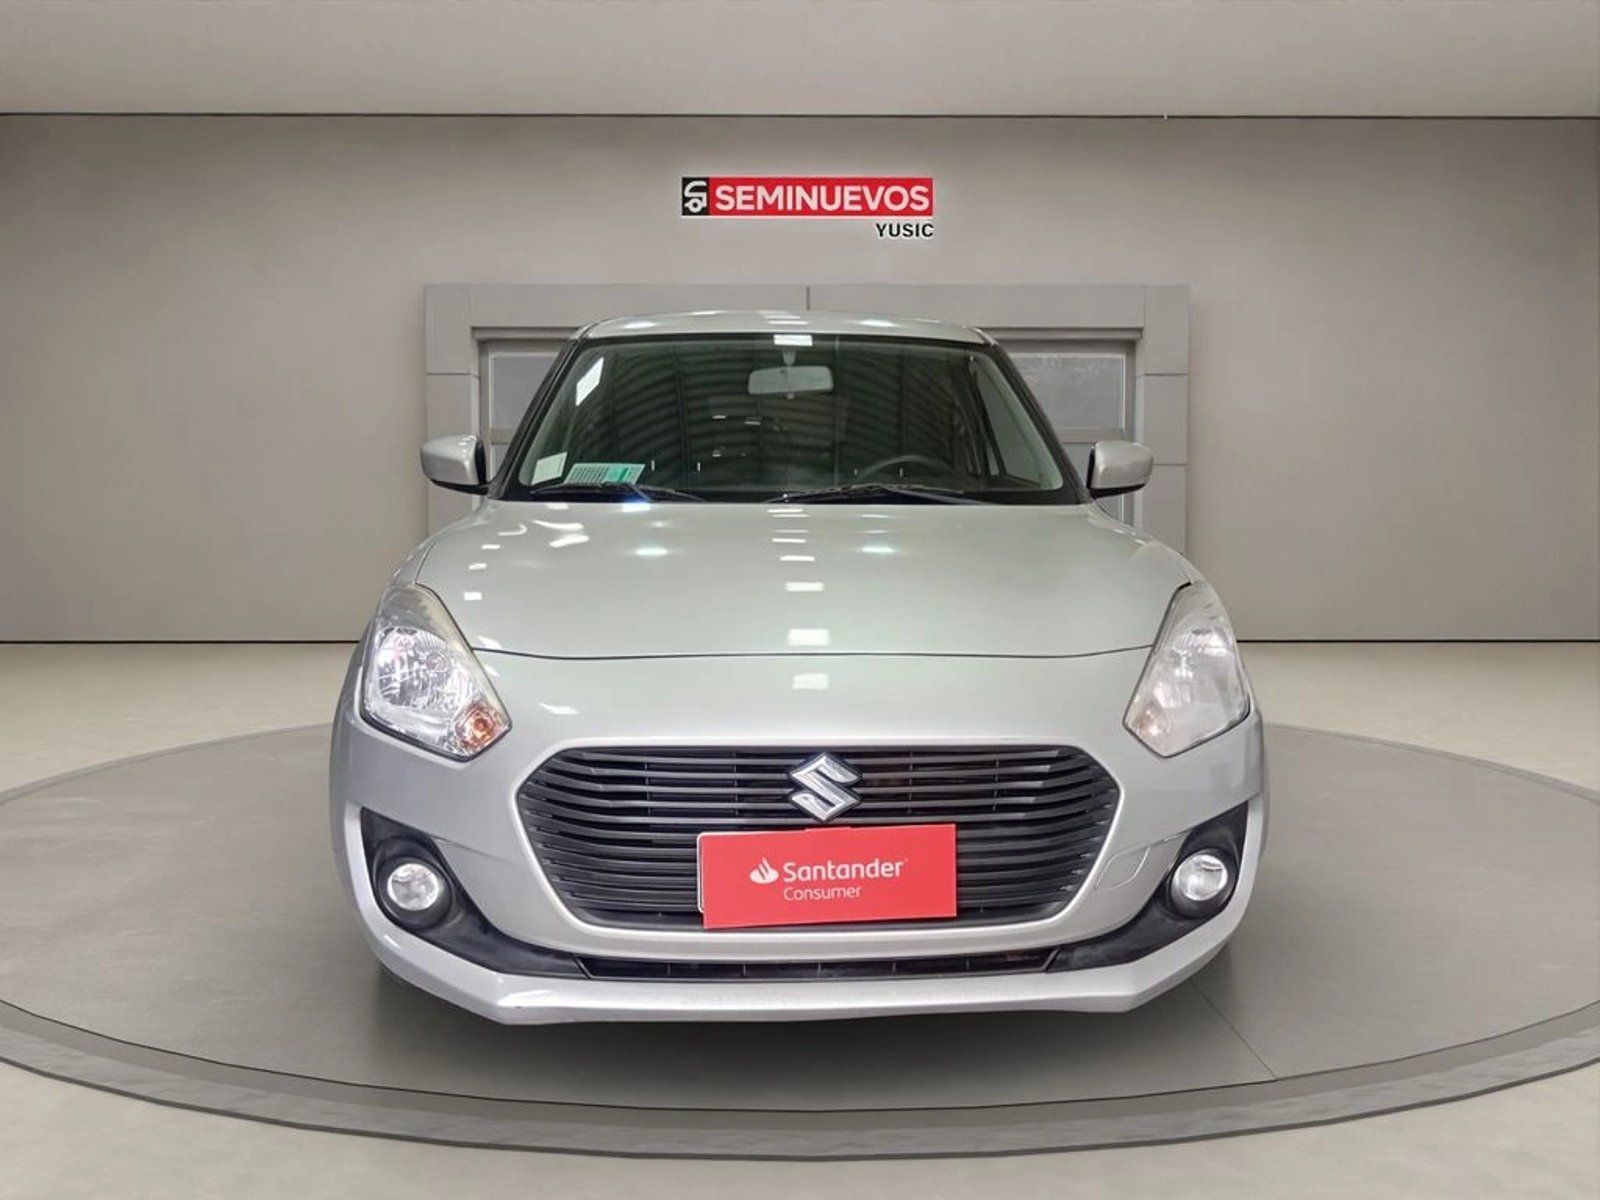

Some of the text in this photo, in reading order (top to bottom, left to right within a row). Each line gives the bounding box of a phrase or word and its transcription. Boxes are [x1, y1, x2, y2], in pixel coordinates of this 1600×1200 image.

[715, 185, 929, 211] SEMINUEVOS
[875, 223, 934, 237] YUSIC
[783, 858, 904, 883] Santander
[783, 886, 861, 902] Consumer
